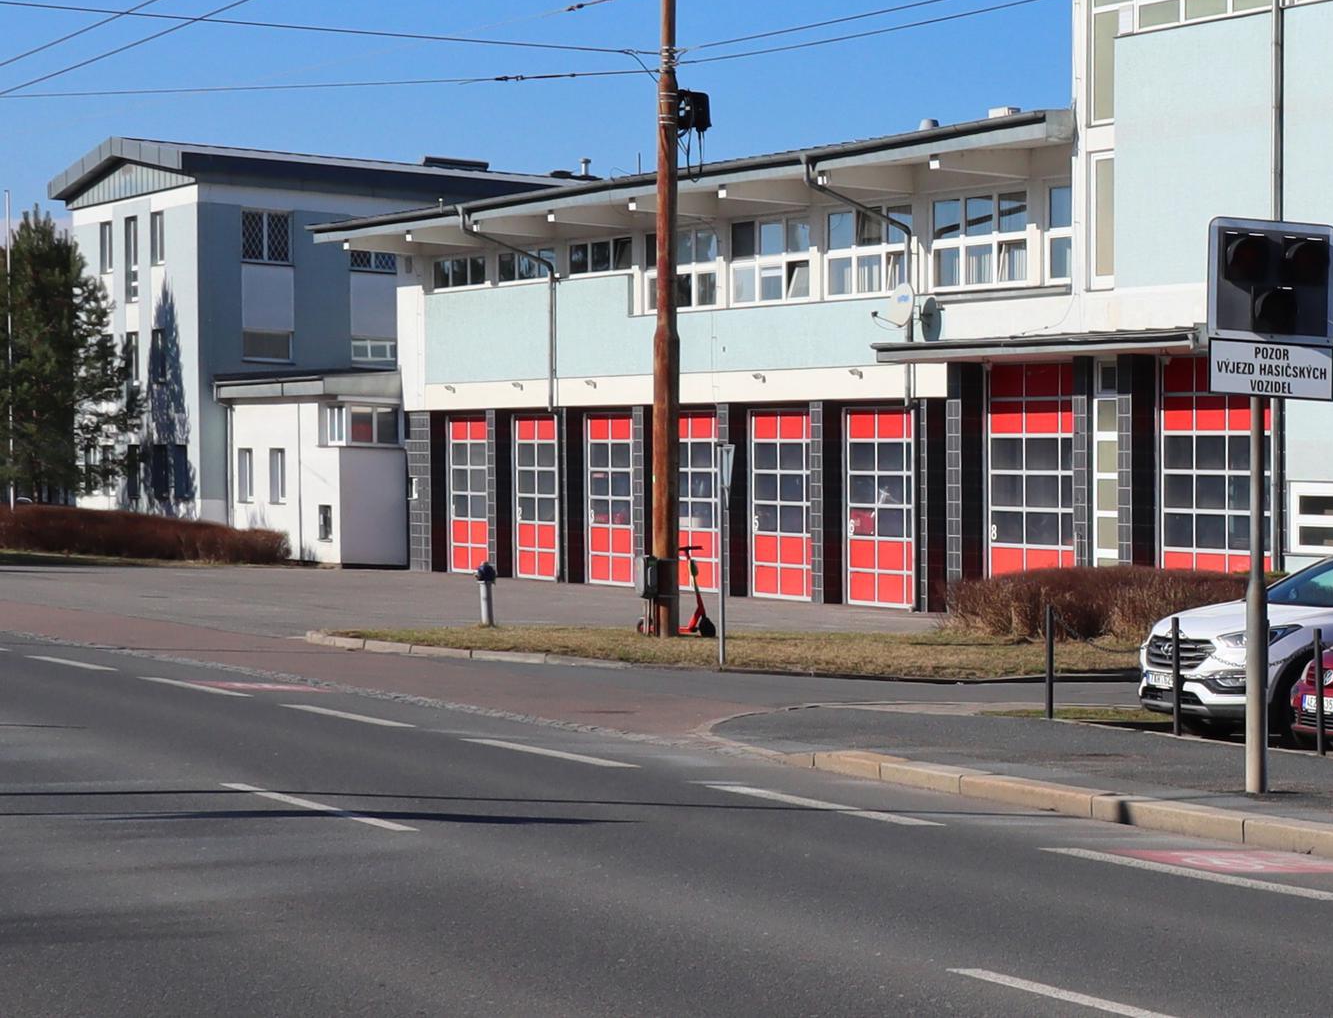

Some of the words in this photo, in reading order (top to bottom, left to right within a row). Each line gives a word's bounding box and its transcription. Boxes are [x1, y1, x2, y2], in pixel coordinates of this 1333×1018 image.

[1254, 346, 1290, 361] POZOR
[1216, 358, 1255, 375] VÝJEZD
[1259, 363, 1327, 380] HASIČSKÝCH
[1250, 379, 1293, 394] VOZIDEL
[991, 524, 997, 540] 8
